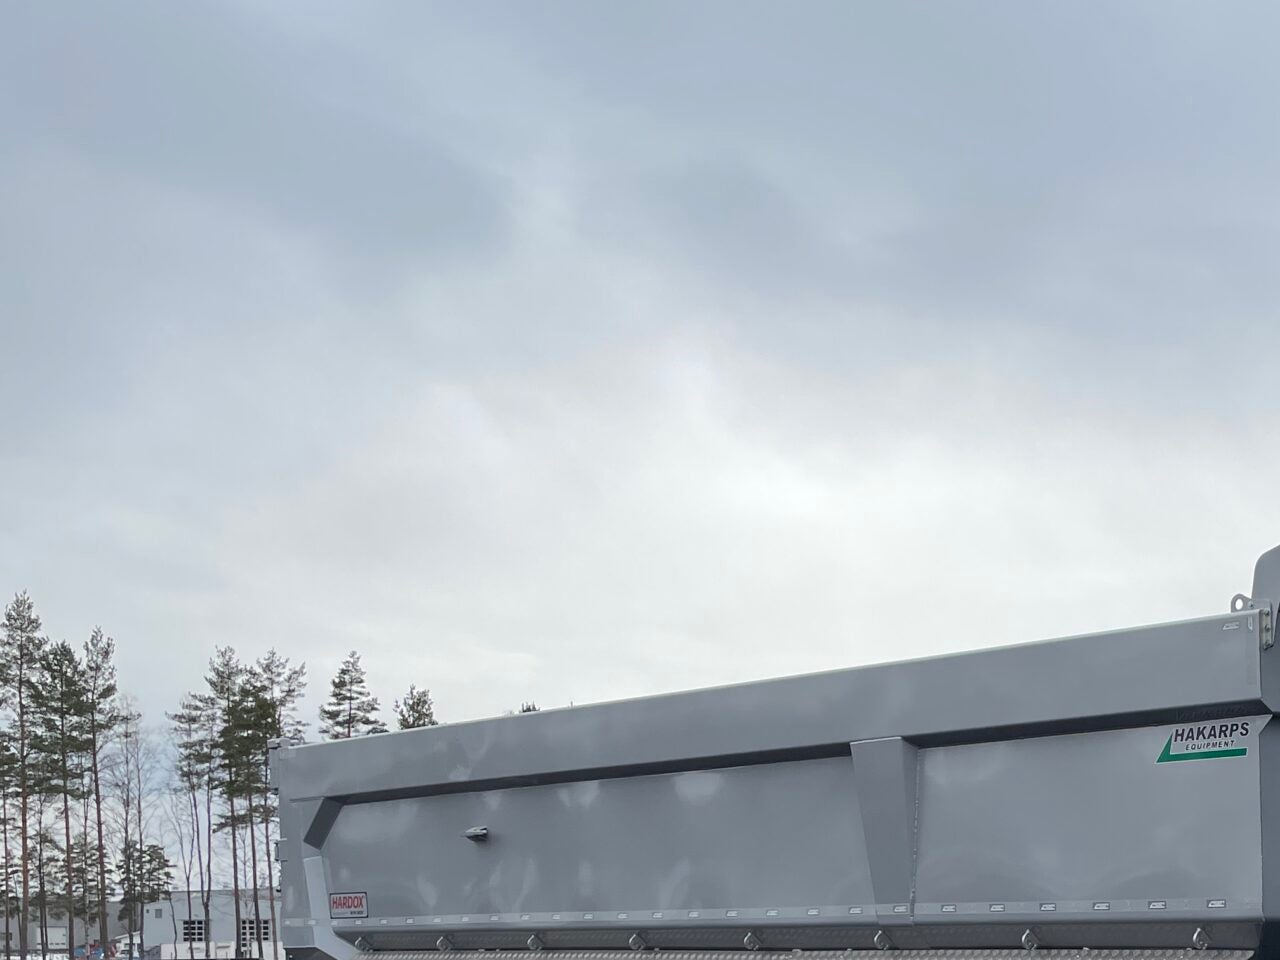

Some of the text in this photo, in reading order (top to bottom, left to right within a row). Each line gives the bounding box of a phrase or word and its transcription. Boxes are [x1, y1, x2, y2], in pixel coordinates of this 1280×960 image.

[1174, 722, 1250, 743] HAKARPS
[1185, 740, 1235, 751] EQUIPMENT
[332, 896, 364, 909] HARDOX
